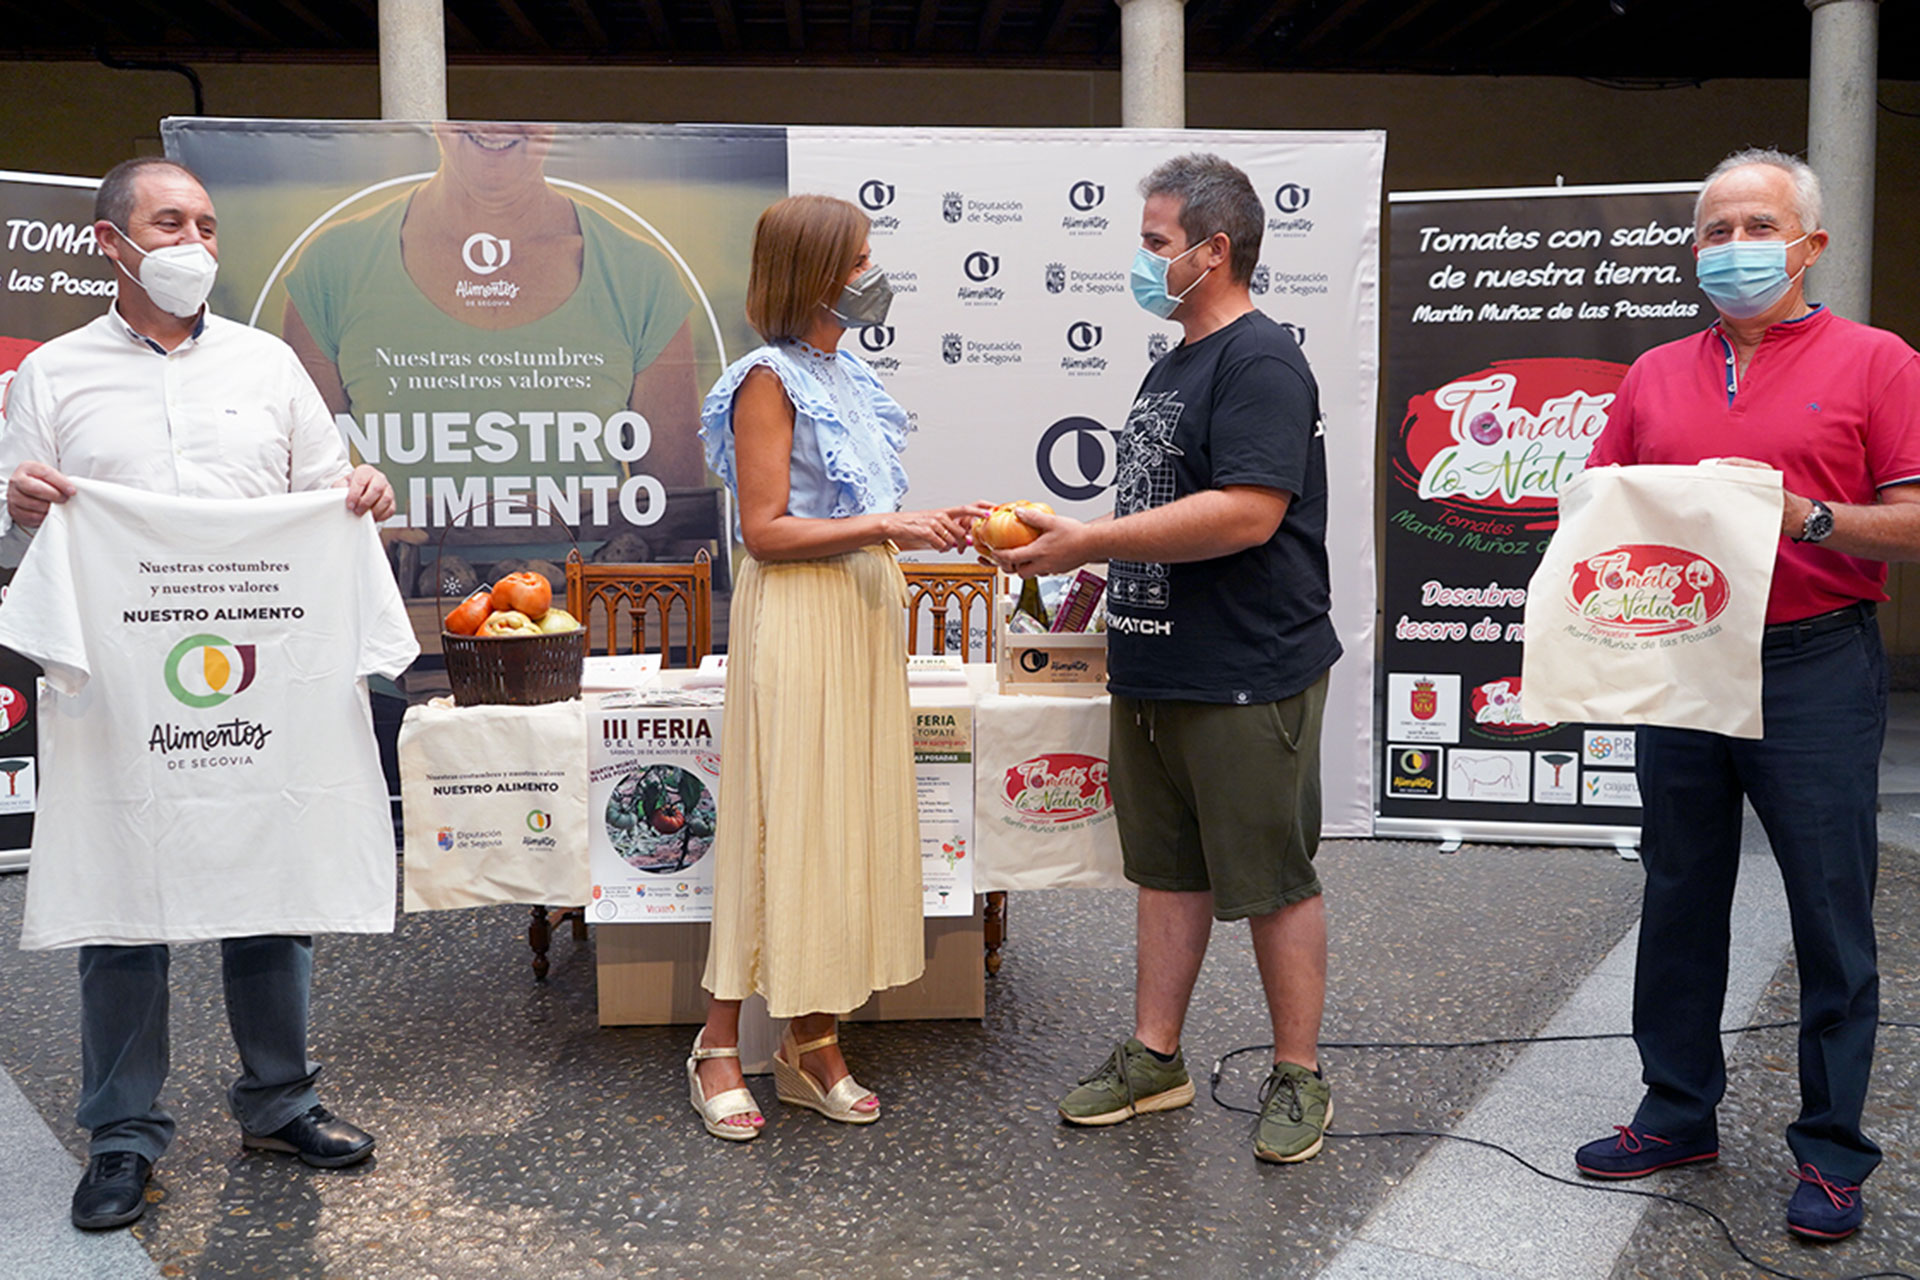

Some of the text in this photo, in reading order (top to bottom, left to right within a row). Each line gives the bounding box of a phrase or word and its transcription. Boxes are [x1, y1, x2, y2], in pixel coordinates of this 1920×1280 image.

[968, 200, 1022, 213] Diputación
[968, 213, 1022, 224] de Segovia
[6, 220, 104, 256] TOMA
[1419, 221, 1695, 252] Tomates con sabor
[8, 268, 45, 292] las
[1070, 271, 1125, 284] Diputación
[1275, 271, 1328, 284] Diputación
[1429, 260, 1683, 289] de nuestra tierra.
[455, 279, 520, 297] Alimentos
[1070, 284, 1125, 295] de Segovia
[1274, 285, 1328, 296] de Segovia
[1412, 301, 1700, 323] Martín Muñoz de las Posadas
[967, 341, 1022, 353] Diputación
[376, 347, 605, 367] Nuestras costumbres
[967, 354, 1022, 366] de Segovia
[388, 369, 592, 396] y nuestros valores:
[334, 411, 652, 463] NUESTRO
[1436, 508, 1516, 536] Tomates
[1458, 532, 1529, 555] Muñoz
[139, 560, 290, 574] Nuestras costumbres
[150, 580, 280, 597] y nuestros valores
[1421, 580, 1527, 607] Descubre
[123, 606, 304, 623] NUESTRO ALIMENTO
[1604, 590, 1704, 621] Natural
[1396, 615, 1467, 641] tesoro
[1470, 616, 1501, 641] de
[1600, 634, 1636, 650] Muñoz
[1641, 640, 1655, 649] de
[1659, 636, 1678, 648] las
[1682, 622, 1722, 644] Posadas
[603, 718, 712, 739] III FERIA
[916, 715, 956, 726] FERIA
[148, 718, 272, 754] Alimentos
[917, 729, 955, 737] TOMATE
[167, 756, 254, 770] DE SEGOVIA
[433, 782, 559, 795] NUESTRO ALIMENTO
[456, 830, 502, 840] Diputación
